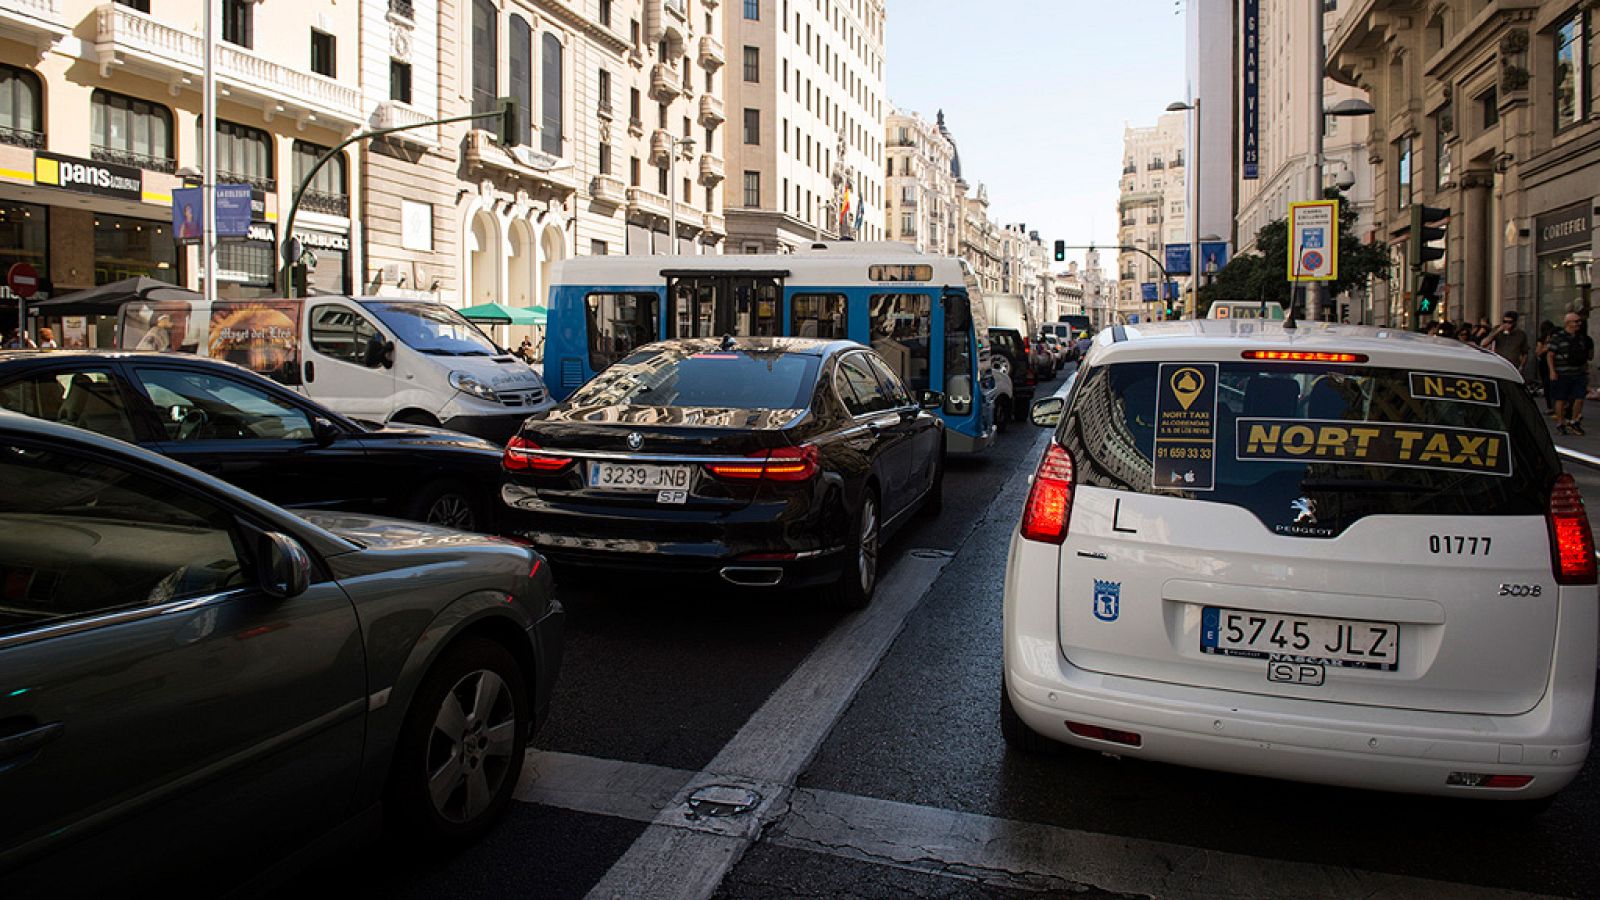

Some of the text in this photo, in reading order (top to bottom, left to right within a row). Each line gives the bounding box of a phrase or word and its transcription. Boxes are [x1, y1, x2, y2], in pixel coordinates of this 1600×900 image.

[1247, 151, 1256, 162] 25
[60, 161, 111, 187] pans
[1543, 216, 1586, 240] CORTEFIEL
[292, 231, 349, 251] STARBUCKS
[1235, 307, 1266, 320] TAX
[1424, 376, 1487, 400] N-33
[1162, 411, 1210, 420] NORT TAXI
[1157, 447, 1212, 460] 91 659 33 33
[1247, 424, 1500, 467] NORT TAXI
[602, 466, 687, 487] 3239 JNB
[660, 490, 685, 502] SP
[1112, 497, 1137, 534] L
[1275, 524, 1333, 536] PEUGEOT
[1429, 535, 1492, 556] 01777
[1498, 583, 1542, 598] 5008
[1207, 630, 1214, 640] E
[1226, 614, 1388, 658] 5745 JLZ
[1274, 664, 1319, 682] SP
